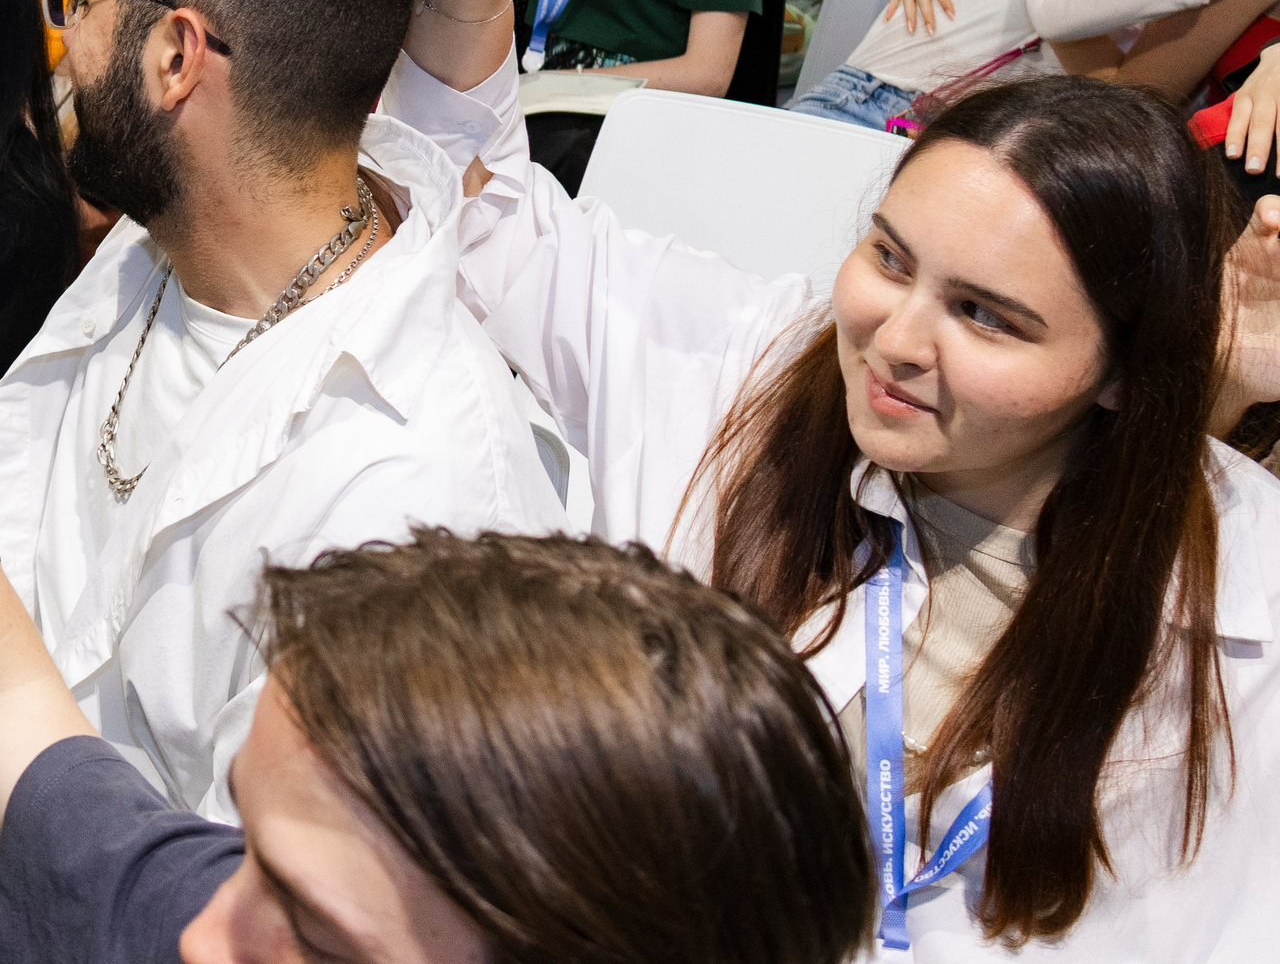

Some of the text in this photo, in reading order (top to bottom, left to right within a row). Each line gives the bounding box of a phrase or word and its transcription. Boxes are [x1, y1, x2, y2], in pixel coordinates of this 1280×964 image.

[878, 581, 890, 653] ЛЮБОВЬ.
[878, 654, 890, 693] МИР.
[879, 759, 894, 855] ИСКУССТВО
[914, 821, 979, 883] ИСКУССТВО
